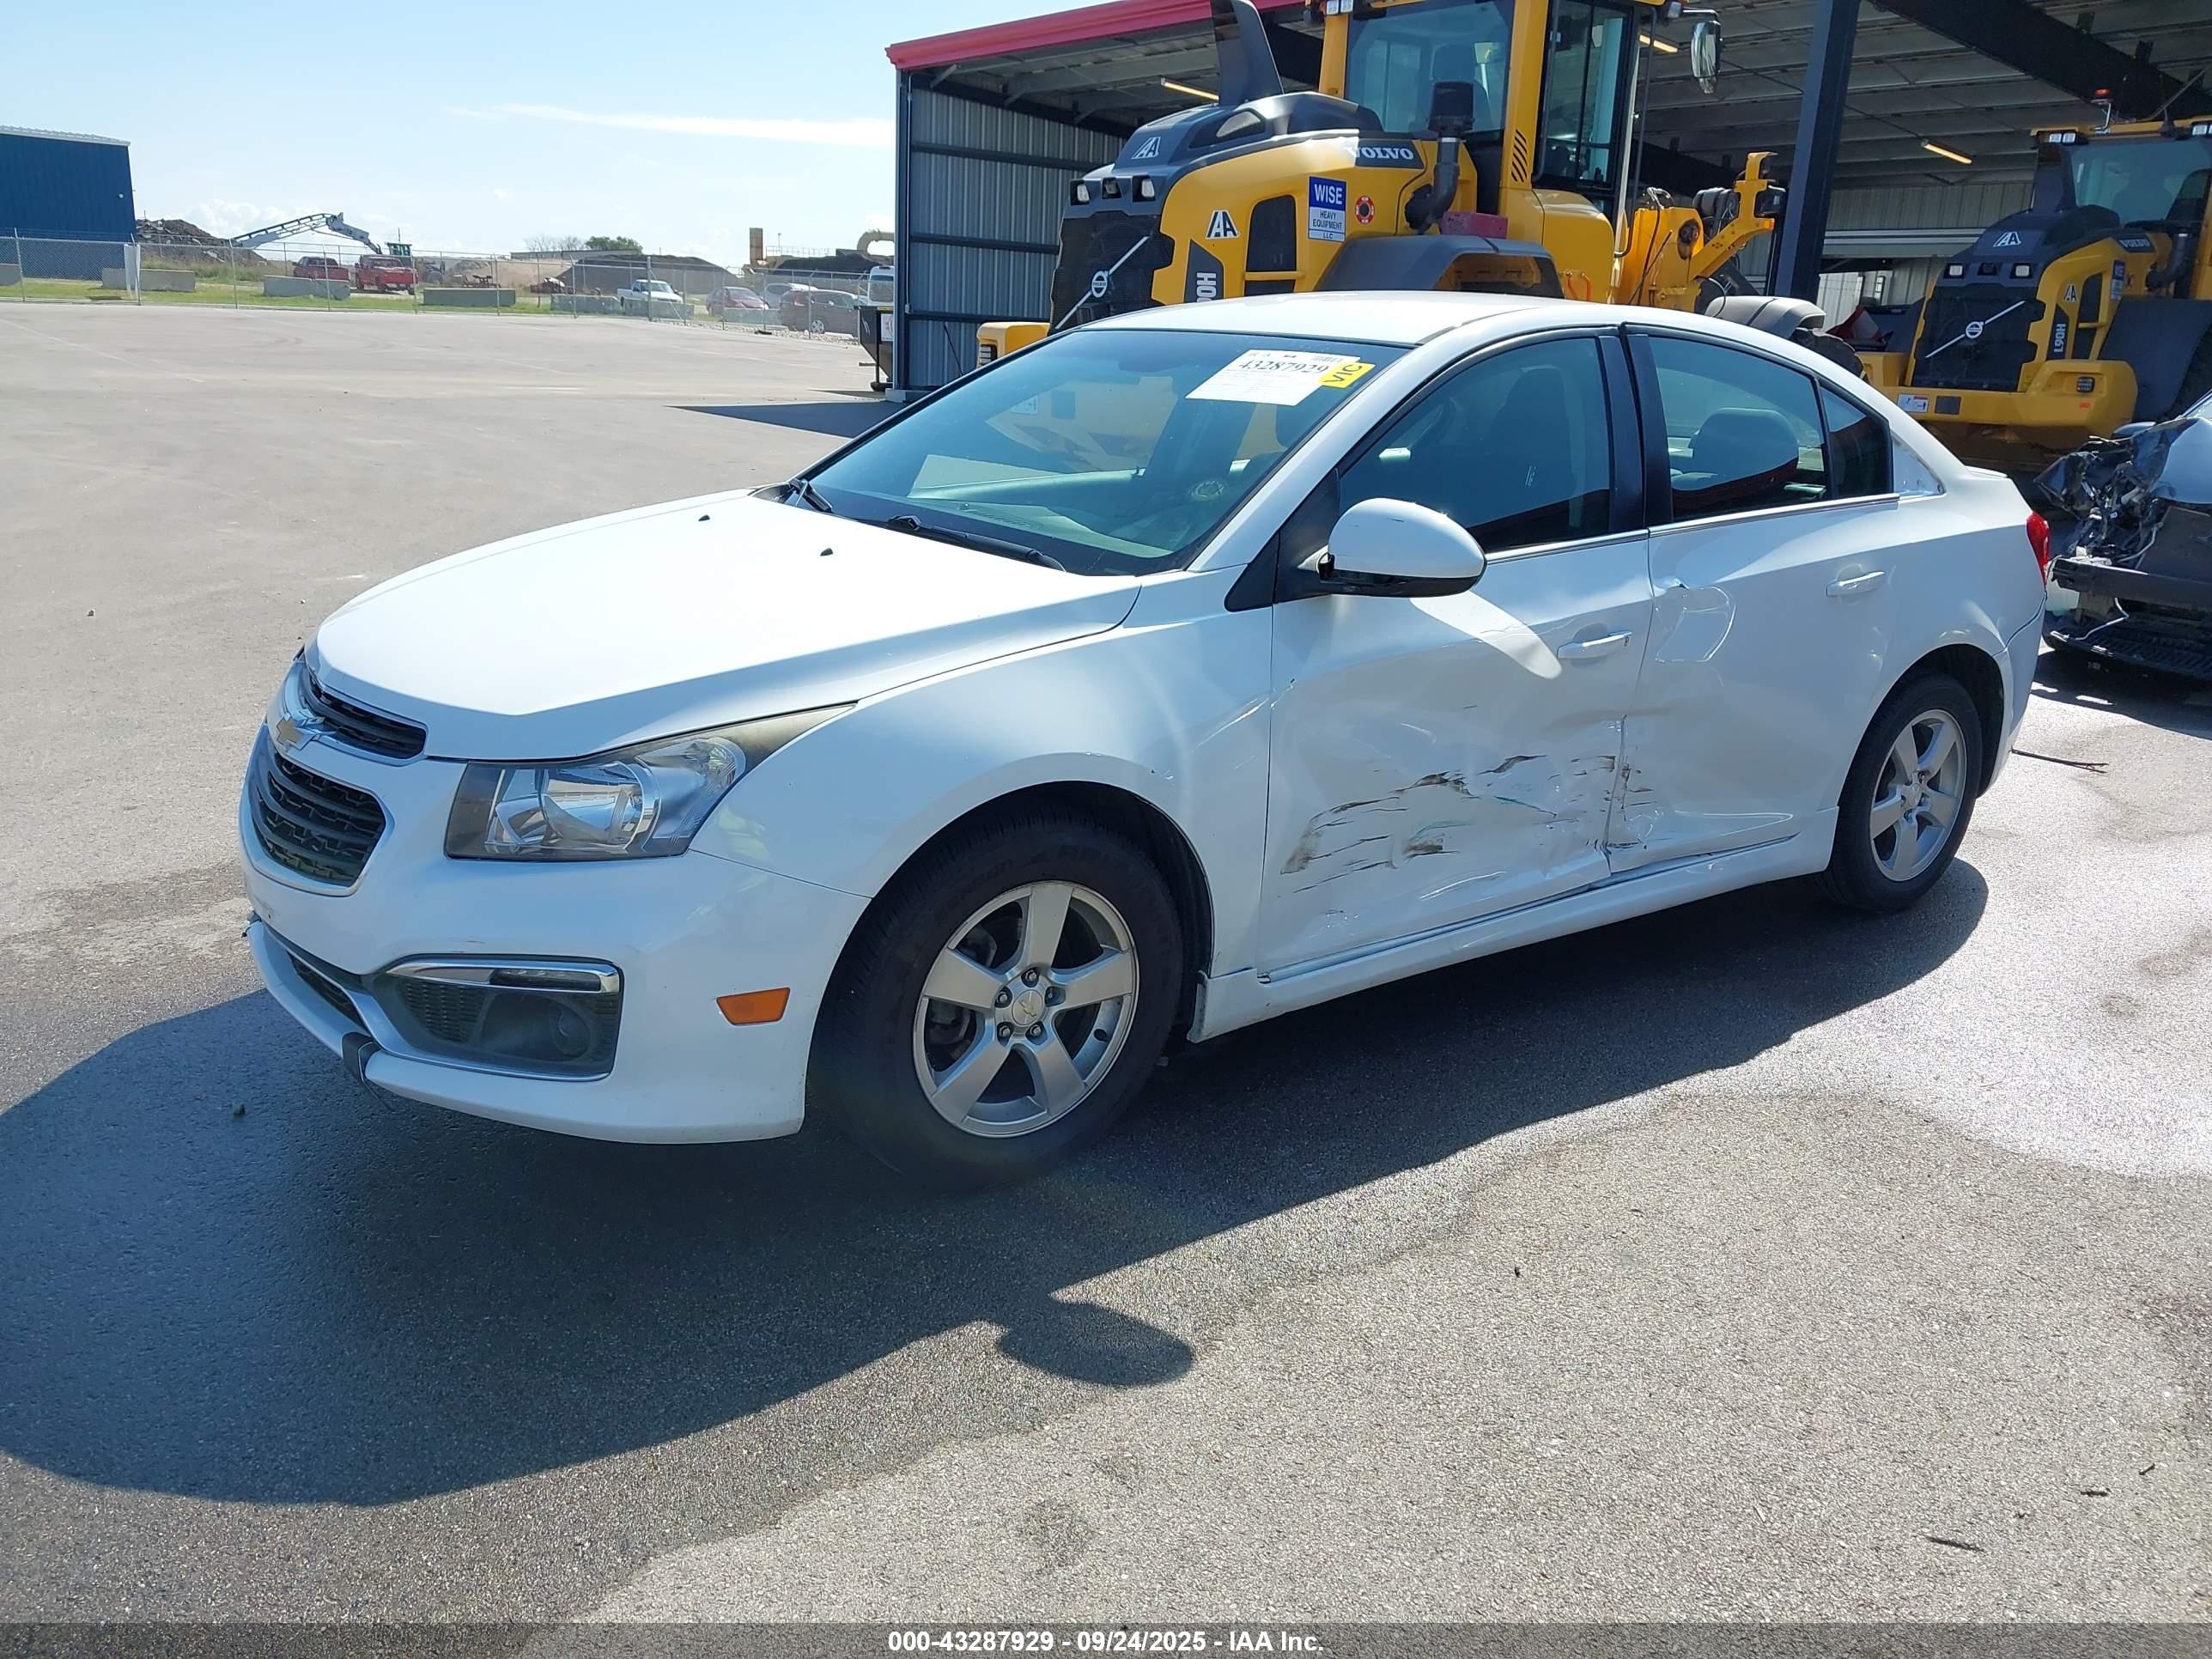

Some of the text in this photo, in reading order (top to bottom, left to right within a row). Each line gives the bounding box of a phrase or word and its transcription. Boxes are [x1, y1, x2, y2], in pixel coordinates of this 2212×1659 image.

[1345, 146, 1414, 160] VOLVO
[1314, 183, 1343, 205] WISE
[1319, 210, 1337, 221] HEAVY
[1312, 218, 1343, 231] EQUIPMENT
[2053, 323, 2066, 353] L90H
[1238, 359, 1329, 374] 43287929
[1323, 363, 1364, 384] VIC
